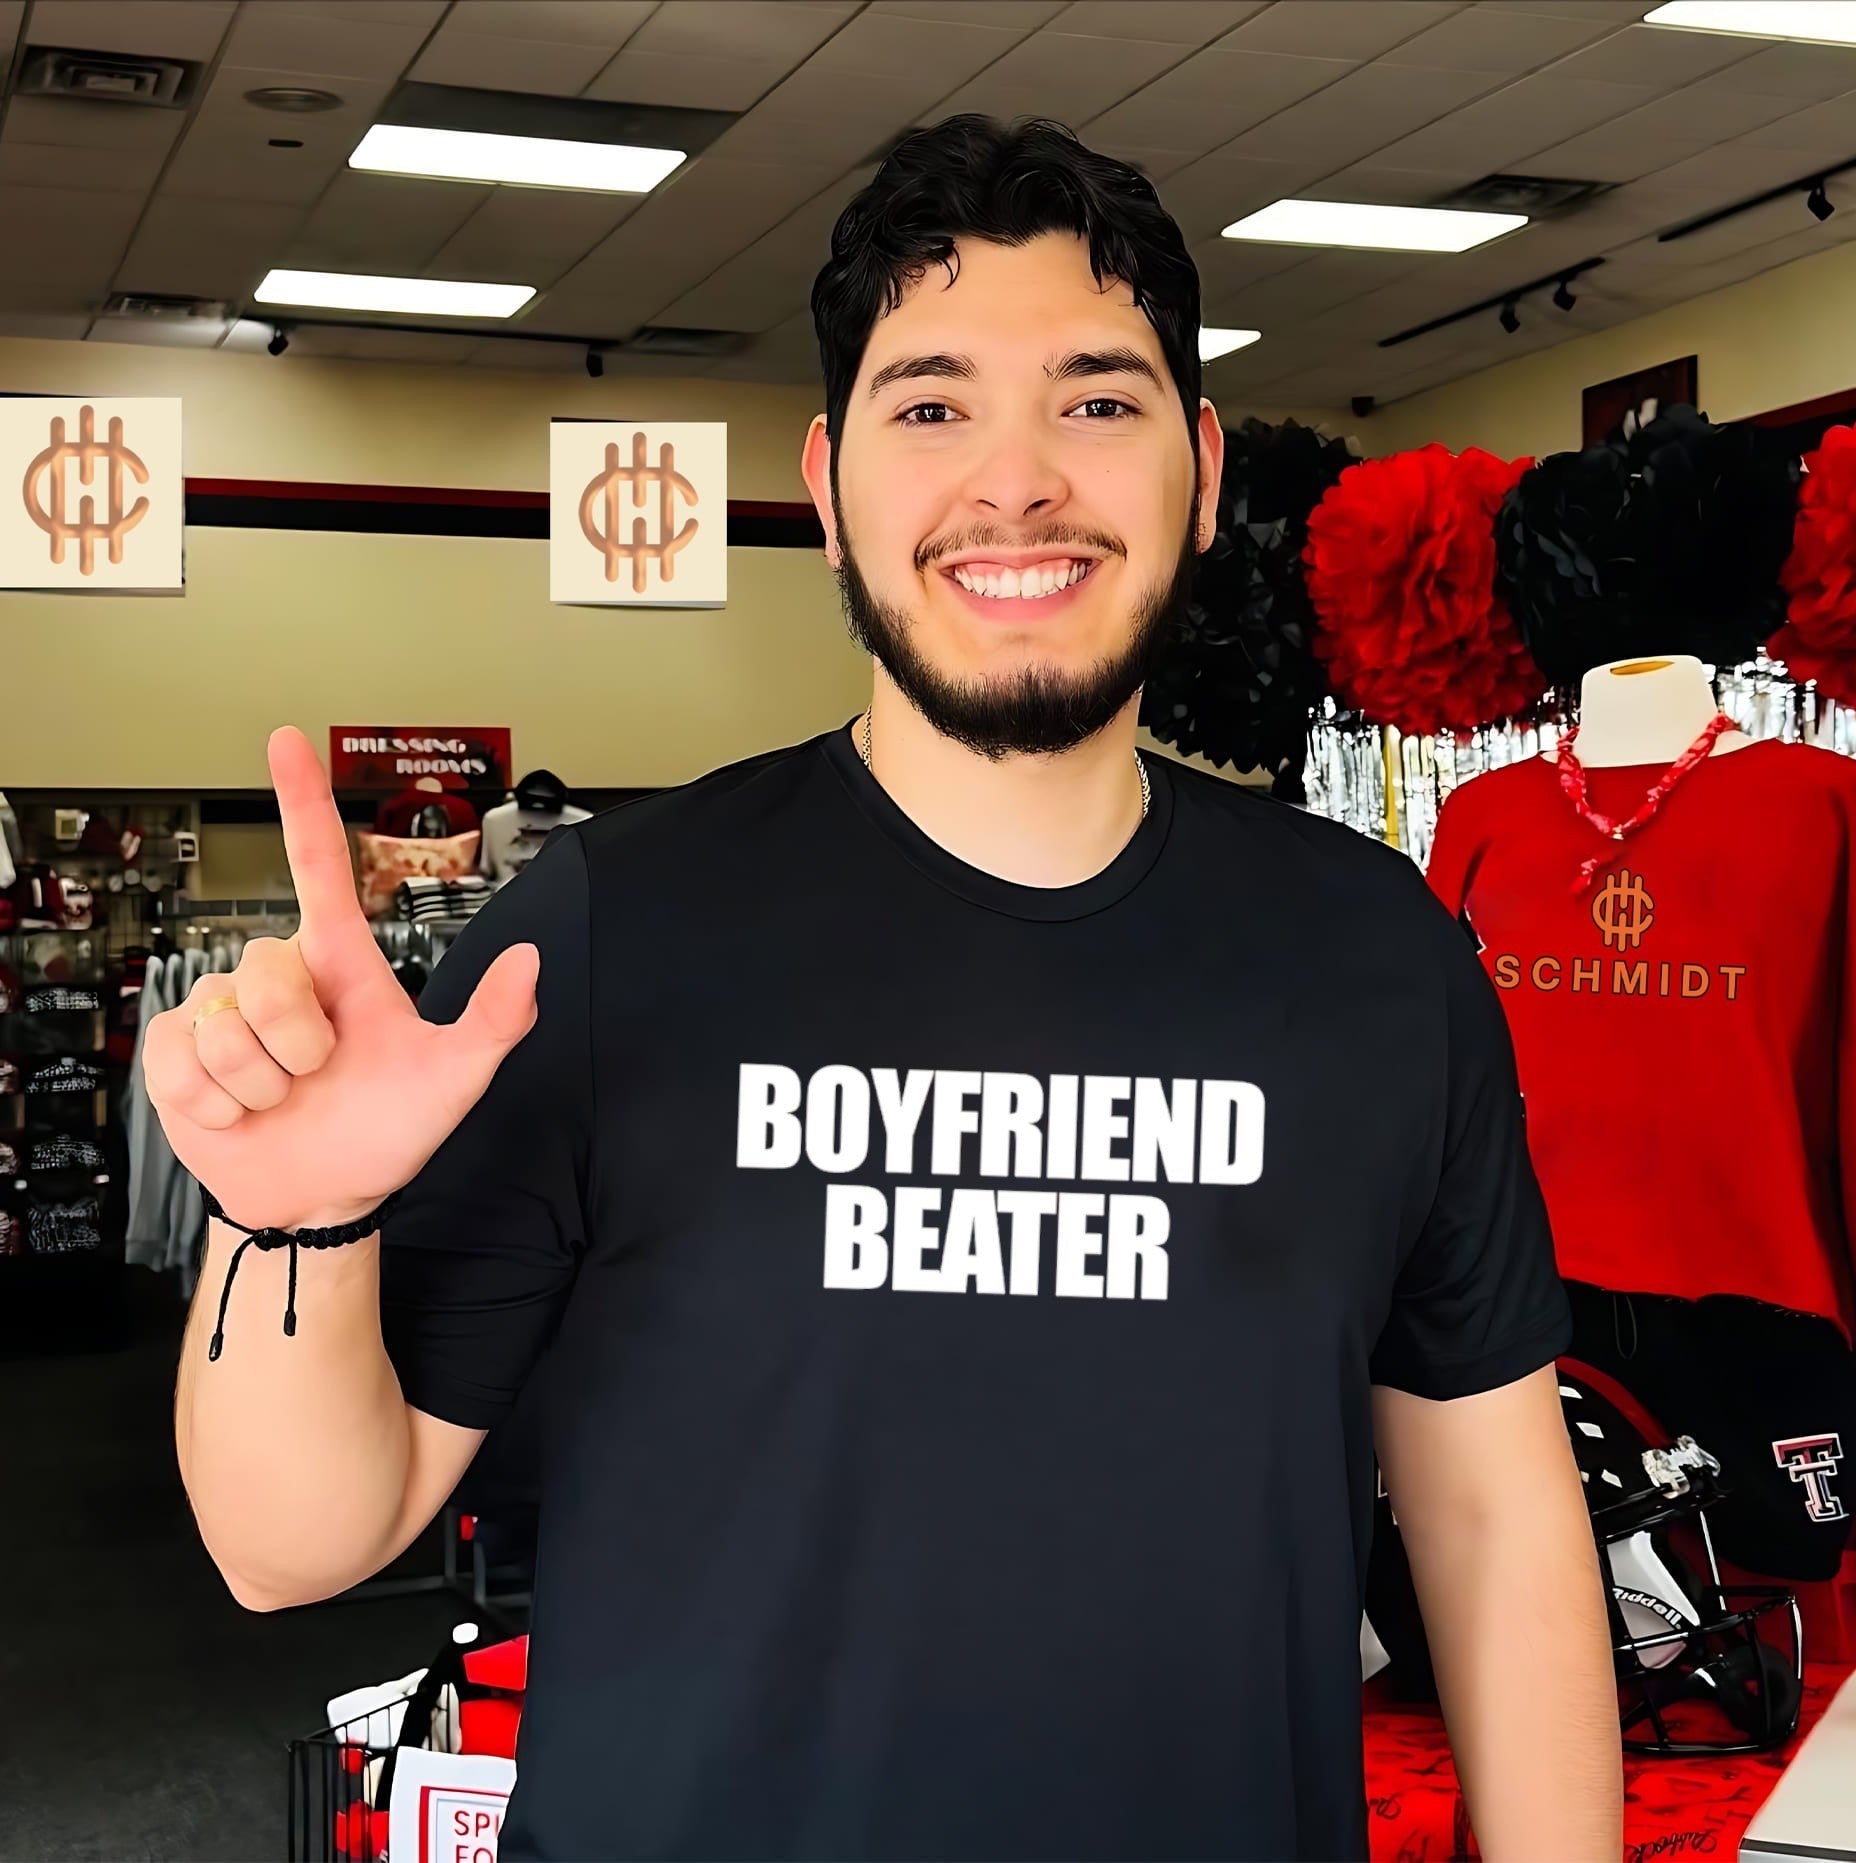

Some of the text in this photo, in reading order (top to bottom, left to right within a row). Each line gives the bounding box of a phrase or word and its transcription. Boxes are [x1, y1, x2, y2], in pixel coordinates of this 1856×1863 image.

[396, 758, 487, 775] ROOMS
[1494, 953, 1746, 1000] SCHMIDT
[736, 1063, 1266, 1186] BOYFRIEND
[823, 1184, 1171, 1301] BEATER
